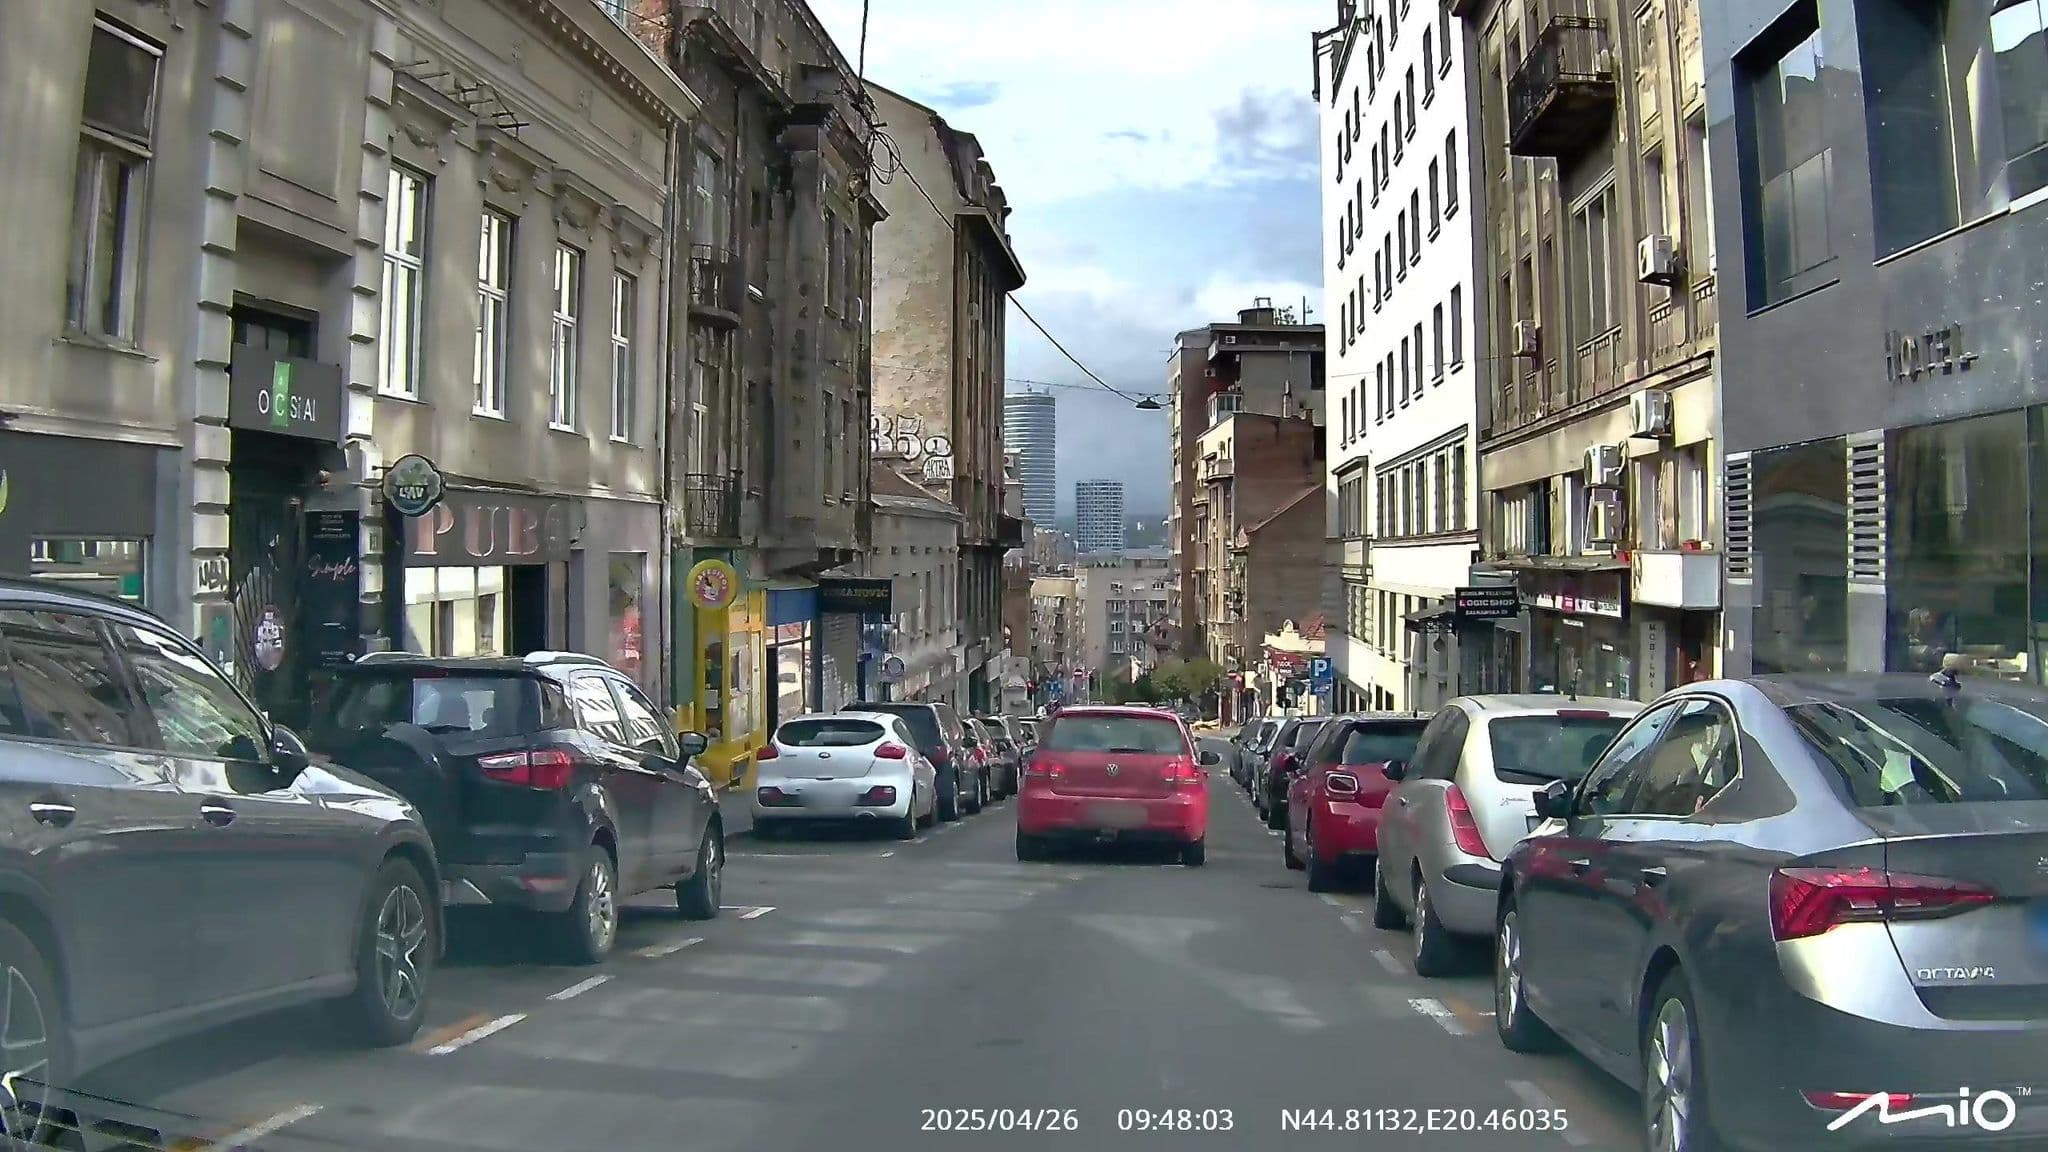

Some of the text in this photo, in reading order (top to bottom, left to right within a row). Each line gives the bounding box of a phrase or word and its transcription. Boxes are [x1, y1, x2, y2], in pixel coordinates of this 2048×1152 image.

[1884, 323, 1979, 385] HOTEL
[412, 502, 539, 557] PUB
[1459, 599, 1515, 607] LOGIC SHOP
[1314, 659, 1328, 677] P
[1917, 967, 1995, 980] OCTAVIA
